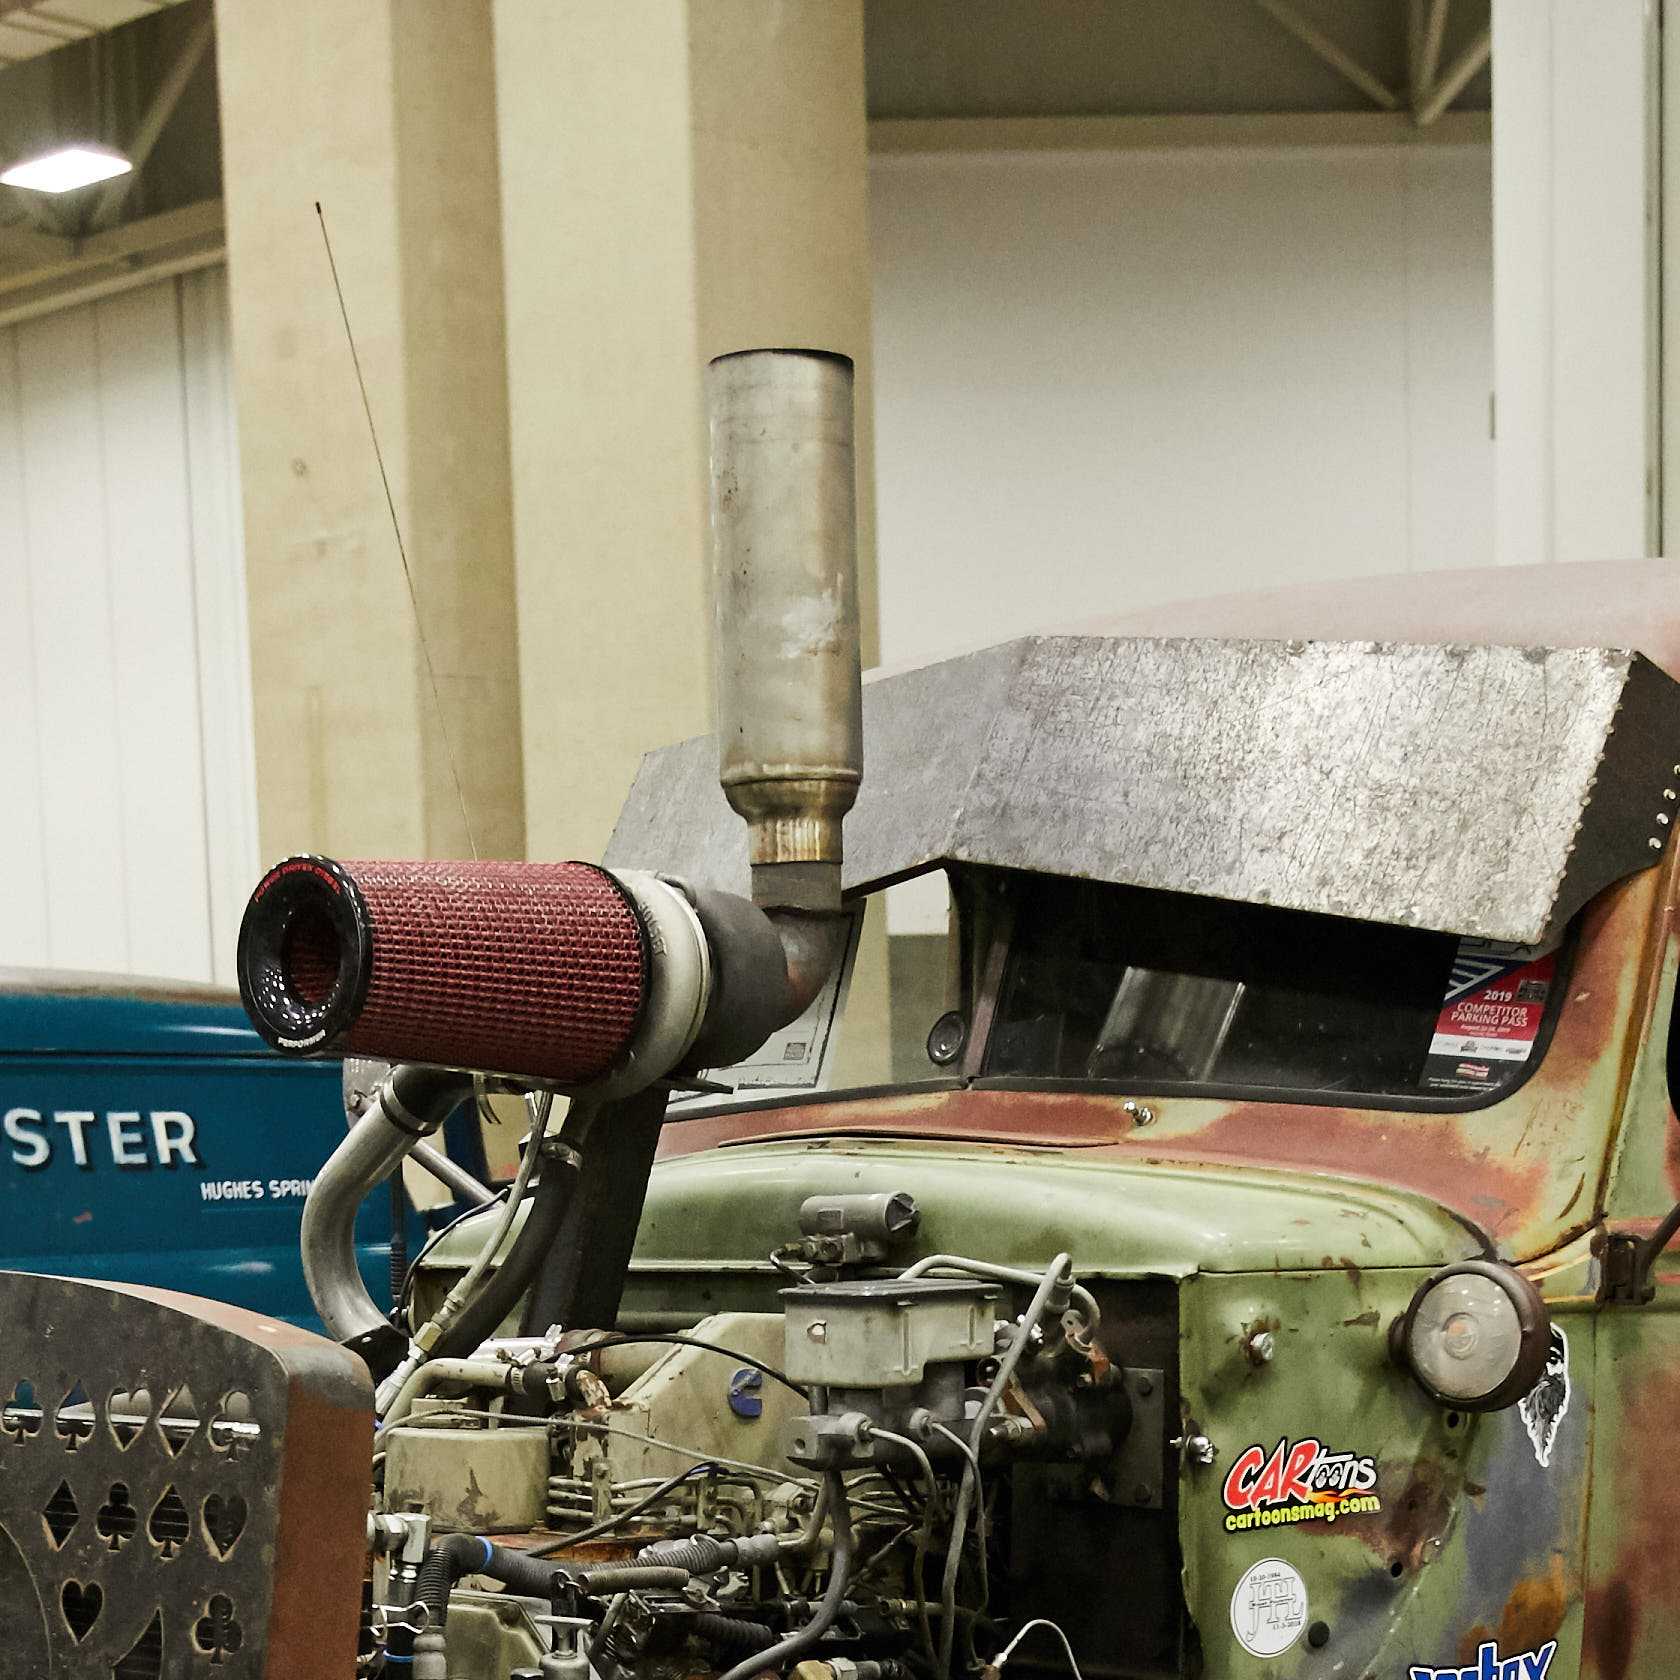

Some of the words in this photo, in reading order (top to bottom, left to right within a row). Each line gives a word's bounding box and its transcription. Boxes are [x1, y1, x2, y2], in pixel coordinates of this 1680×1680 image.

[1483, 989, 1513, 1002] 2019
[1457, 1001, 1528, 1018] COMPETITOR
[1450, 1011, 1500, 1025] PARKING
[1500, 1015, 1529, 1028] PASS
[200, 1180, 265, 1201] HUGHES
[1224, 1495, 1382, 1531] cartoonsmag.com
